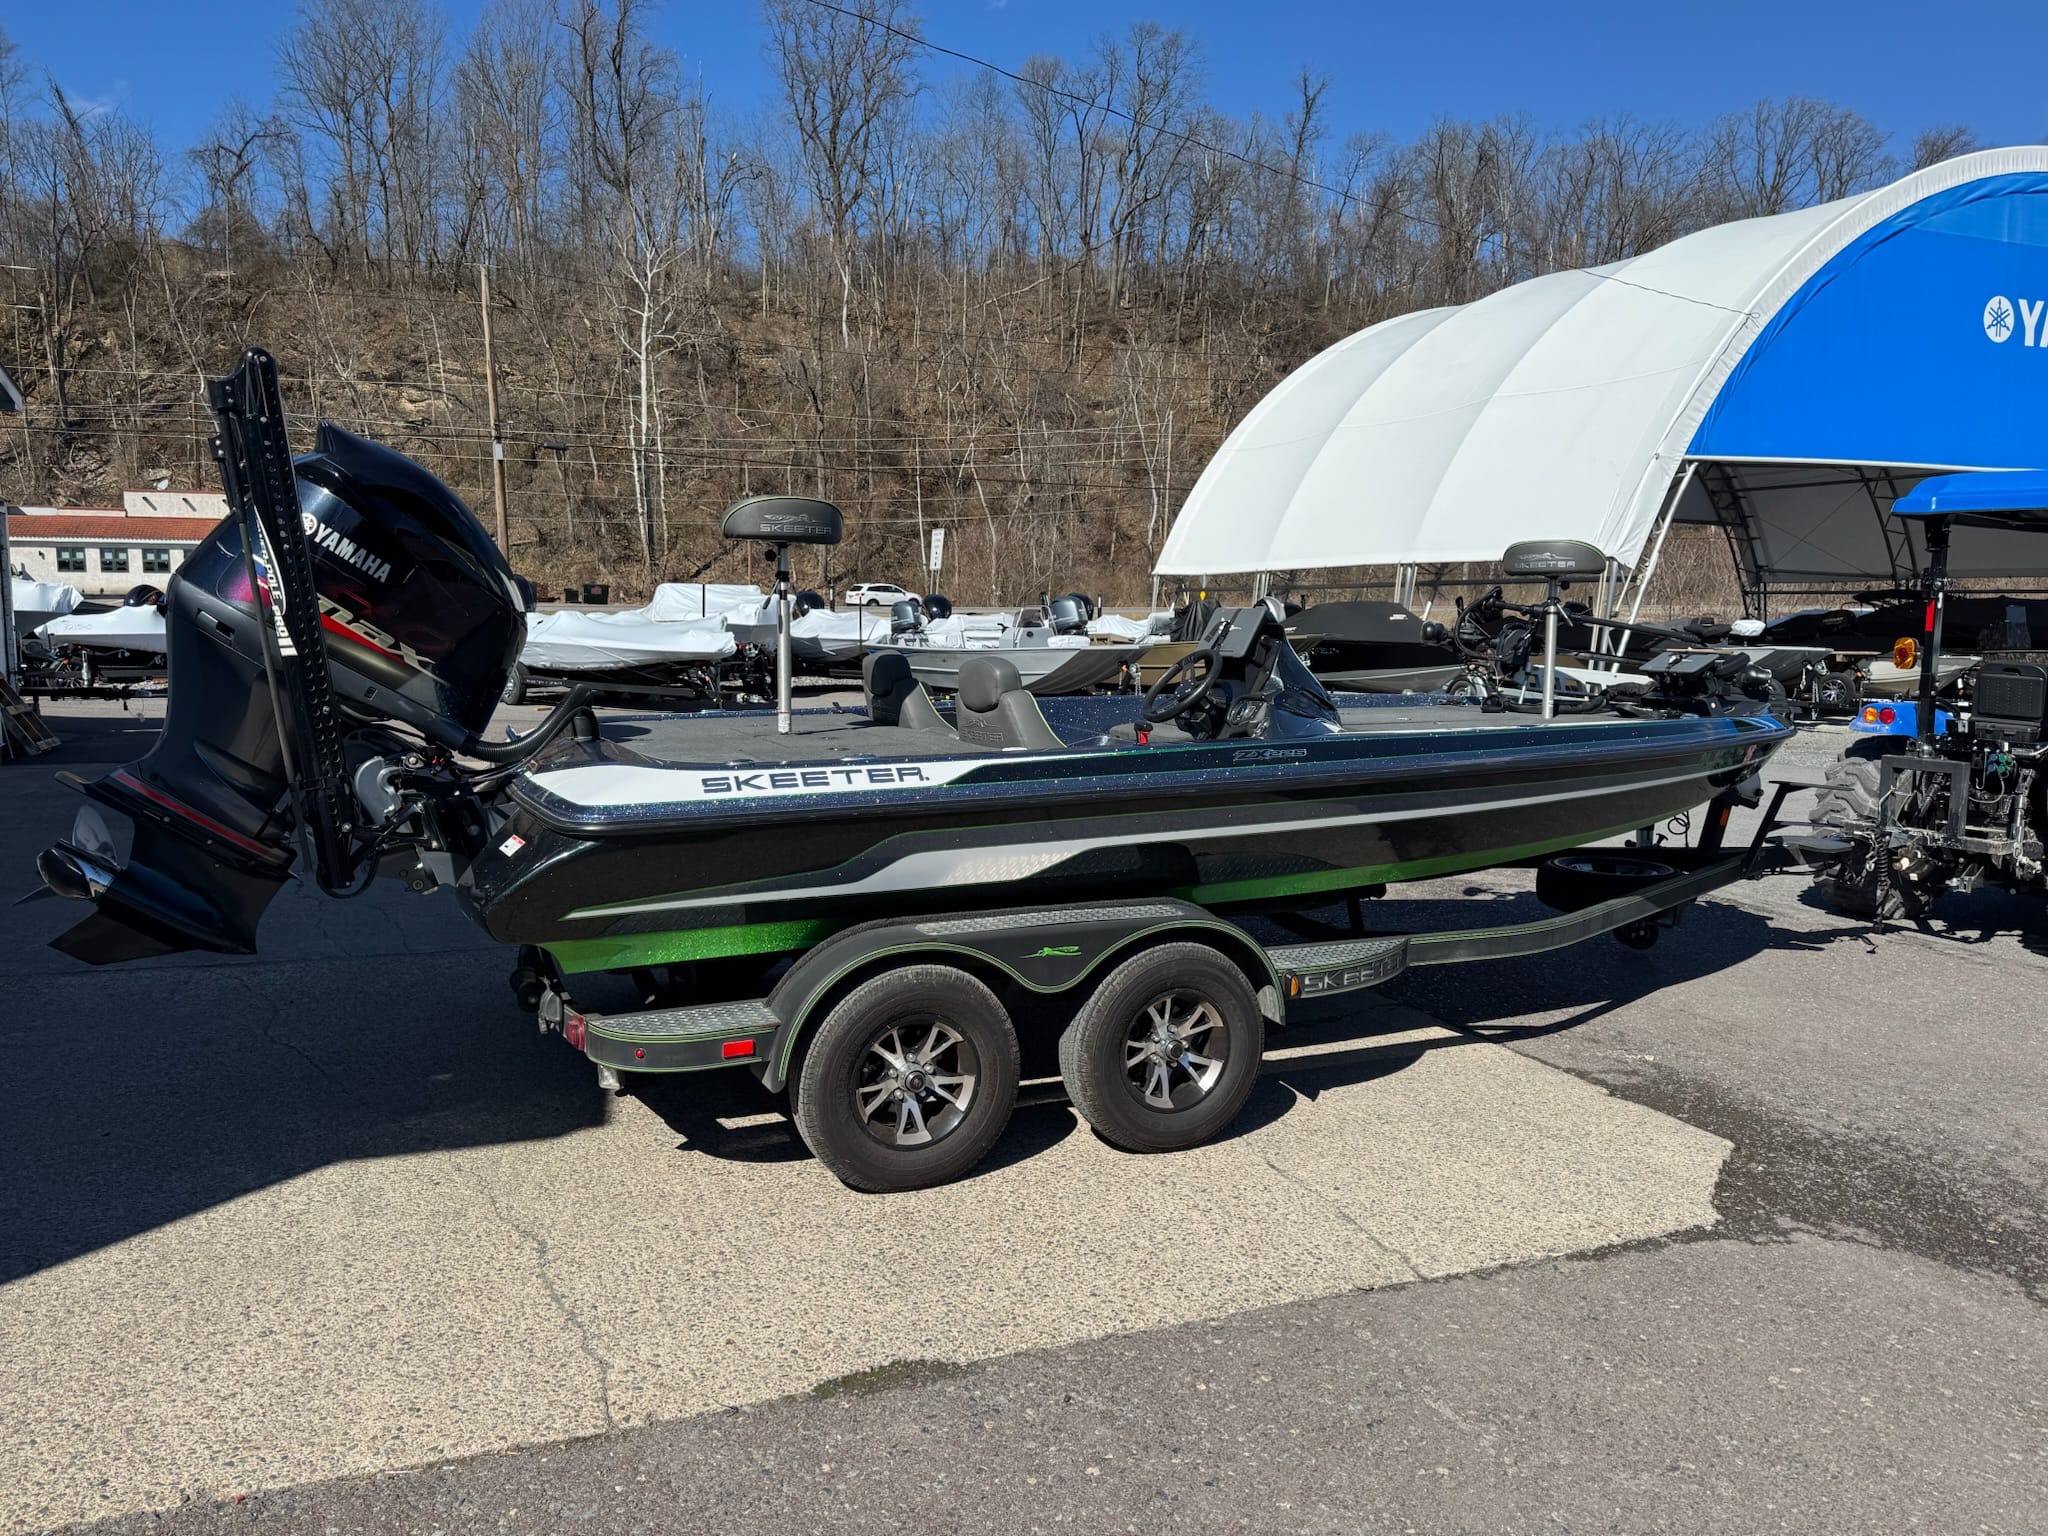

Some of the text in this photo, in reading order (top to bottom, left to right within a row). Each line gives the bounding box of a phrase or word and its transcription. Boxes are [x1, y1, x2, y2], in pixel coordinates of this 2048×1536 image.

[2018, 298, 2048, 348] Y
[313, 523, 392, 584] YAMAHA
[759, 523, 833, 536] SKEETER
